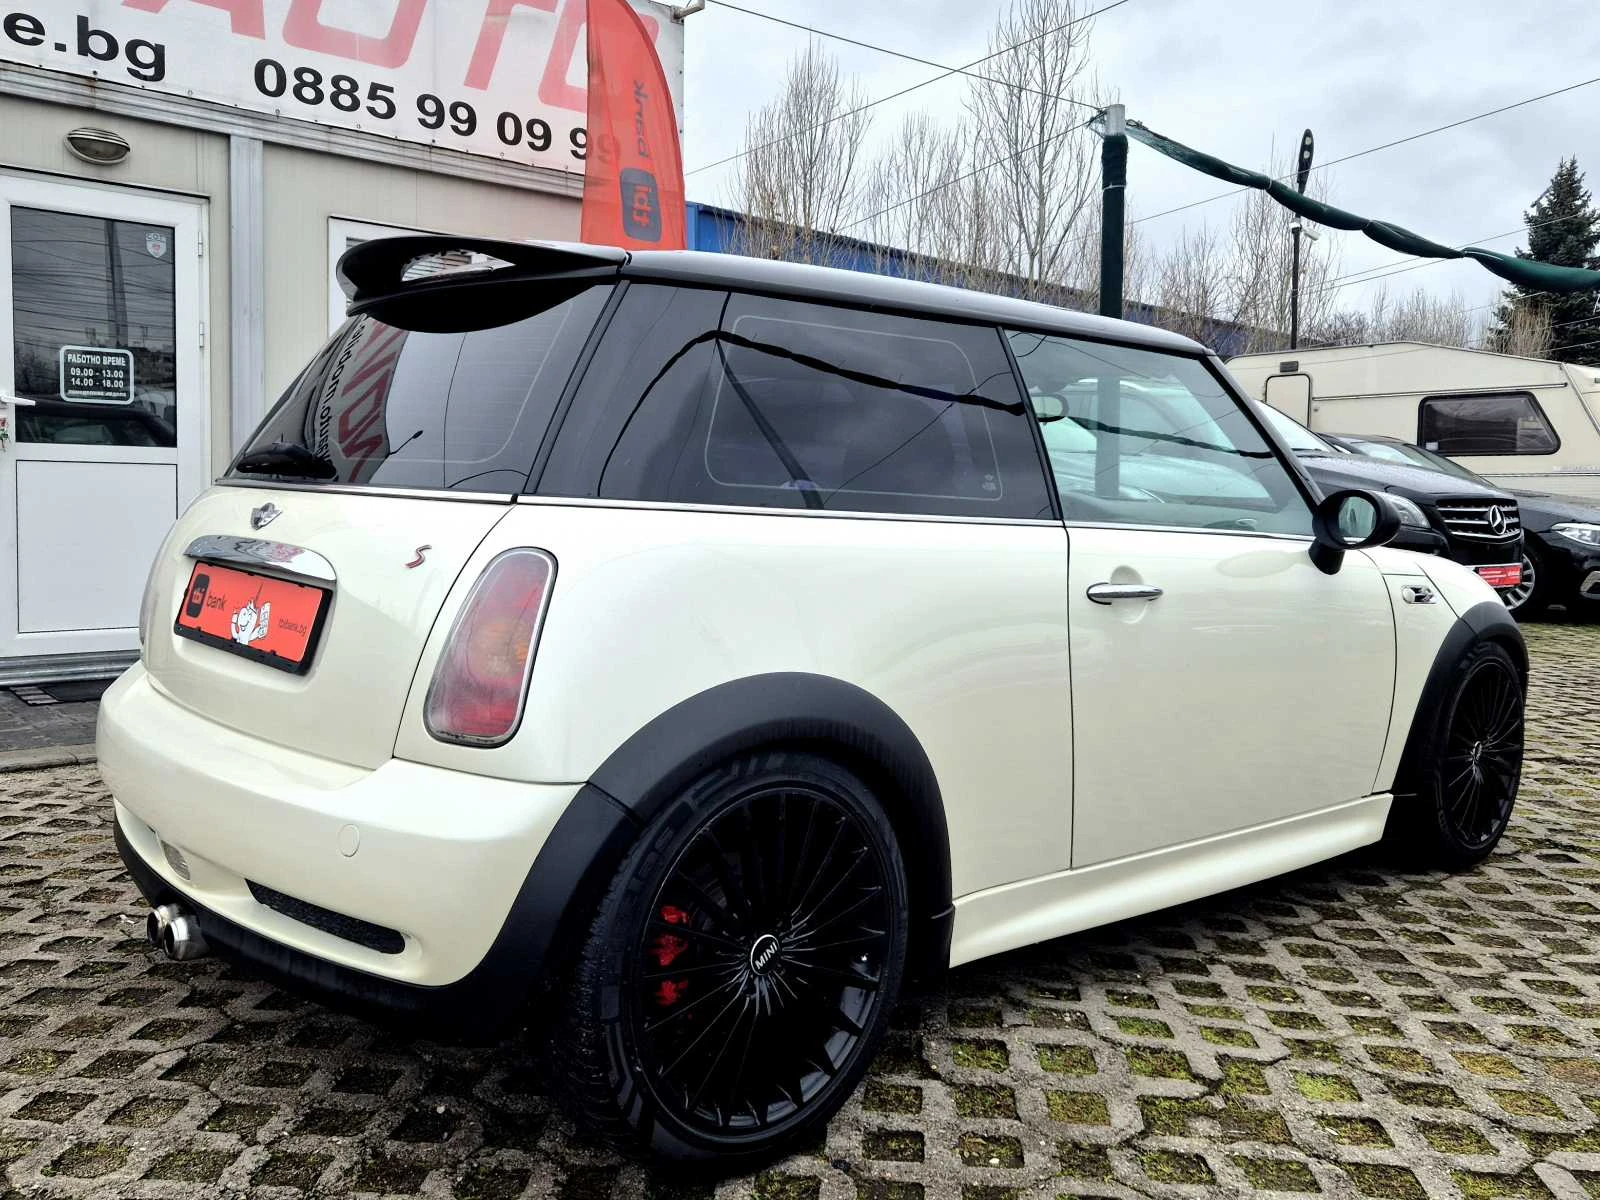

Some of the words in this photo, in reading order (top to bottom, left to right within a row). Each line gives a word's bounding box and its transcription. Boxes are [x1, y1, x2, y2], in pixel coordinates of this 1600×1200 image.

[3, 12, 166, 82] e.bg
[254, 58, 397, 120] 0885
[416, 93, 477, 137] 99
[496, 111, 551, 152] 09
[67, 353, 101, 365] РАБОТНО
[102, 356, 126, 366] ВРЕМЕ
[70, 367, 94, 377] 09.00
[102, 369, 124, 378] 13.00
[71, 377, 94, 387] 14.00
[102, 379, 124, 388] 18.00
[755, 942, 778, 970] MINI
